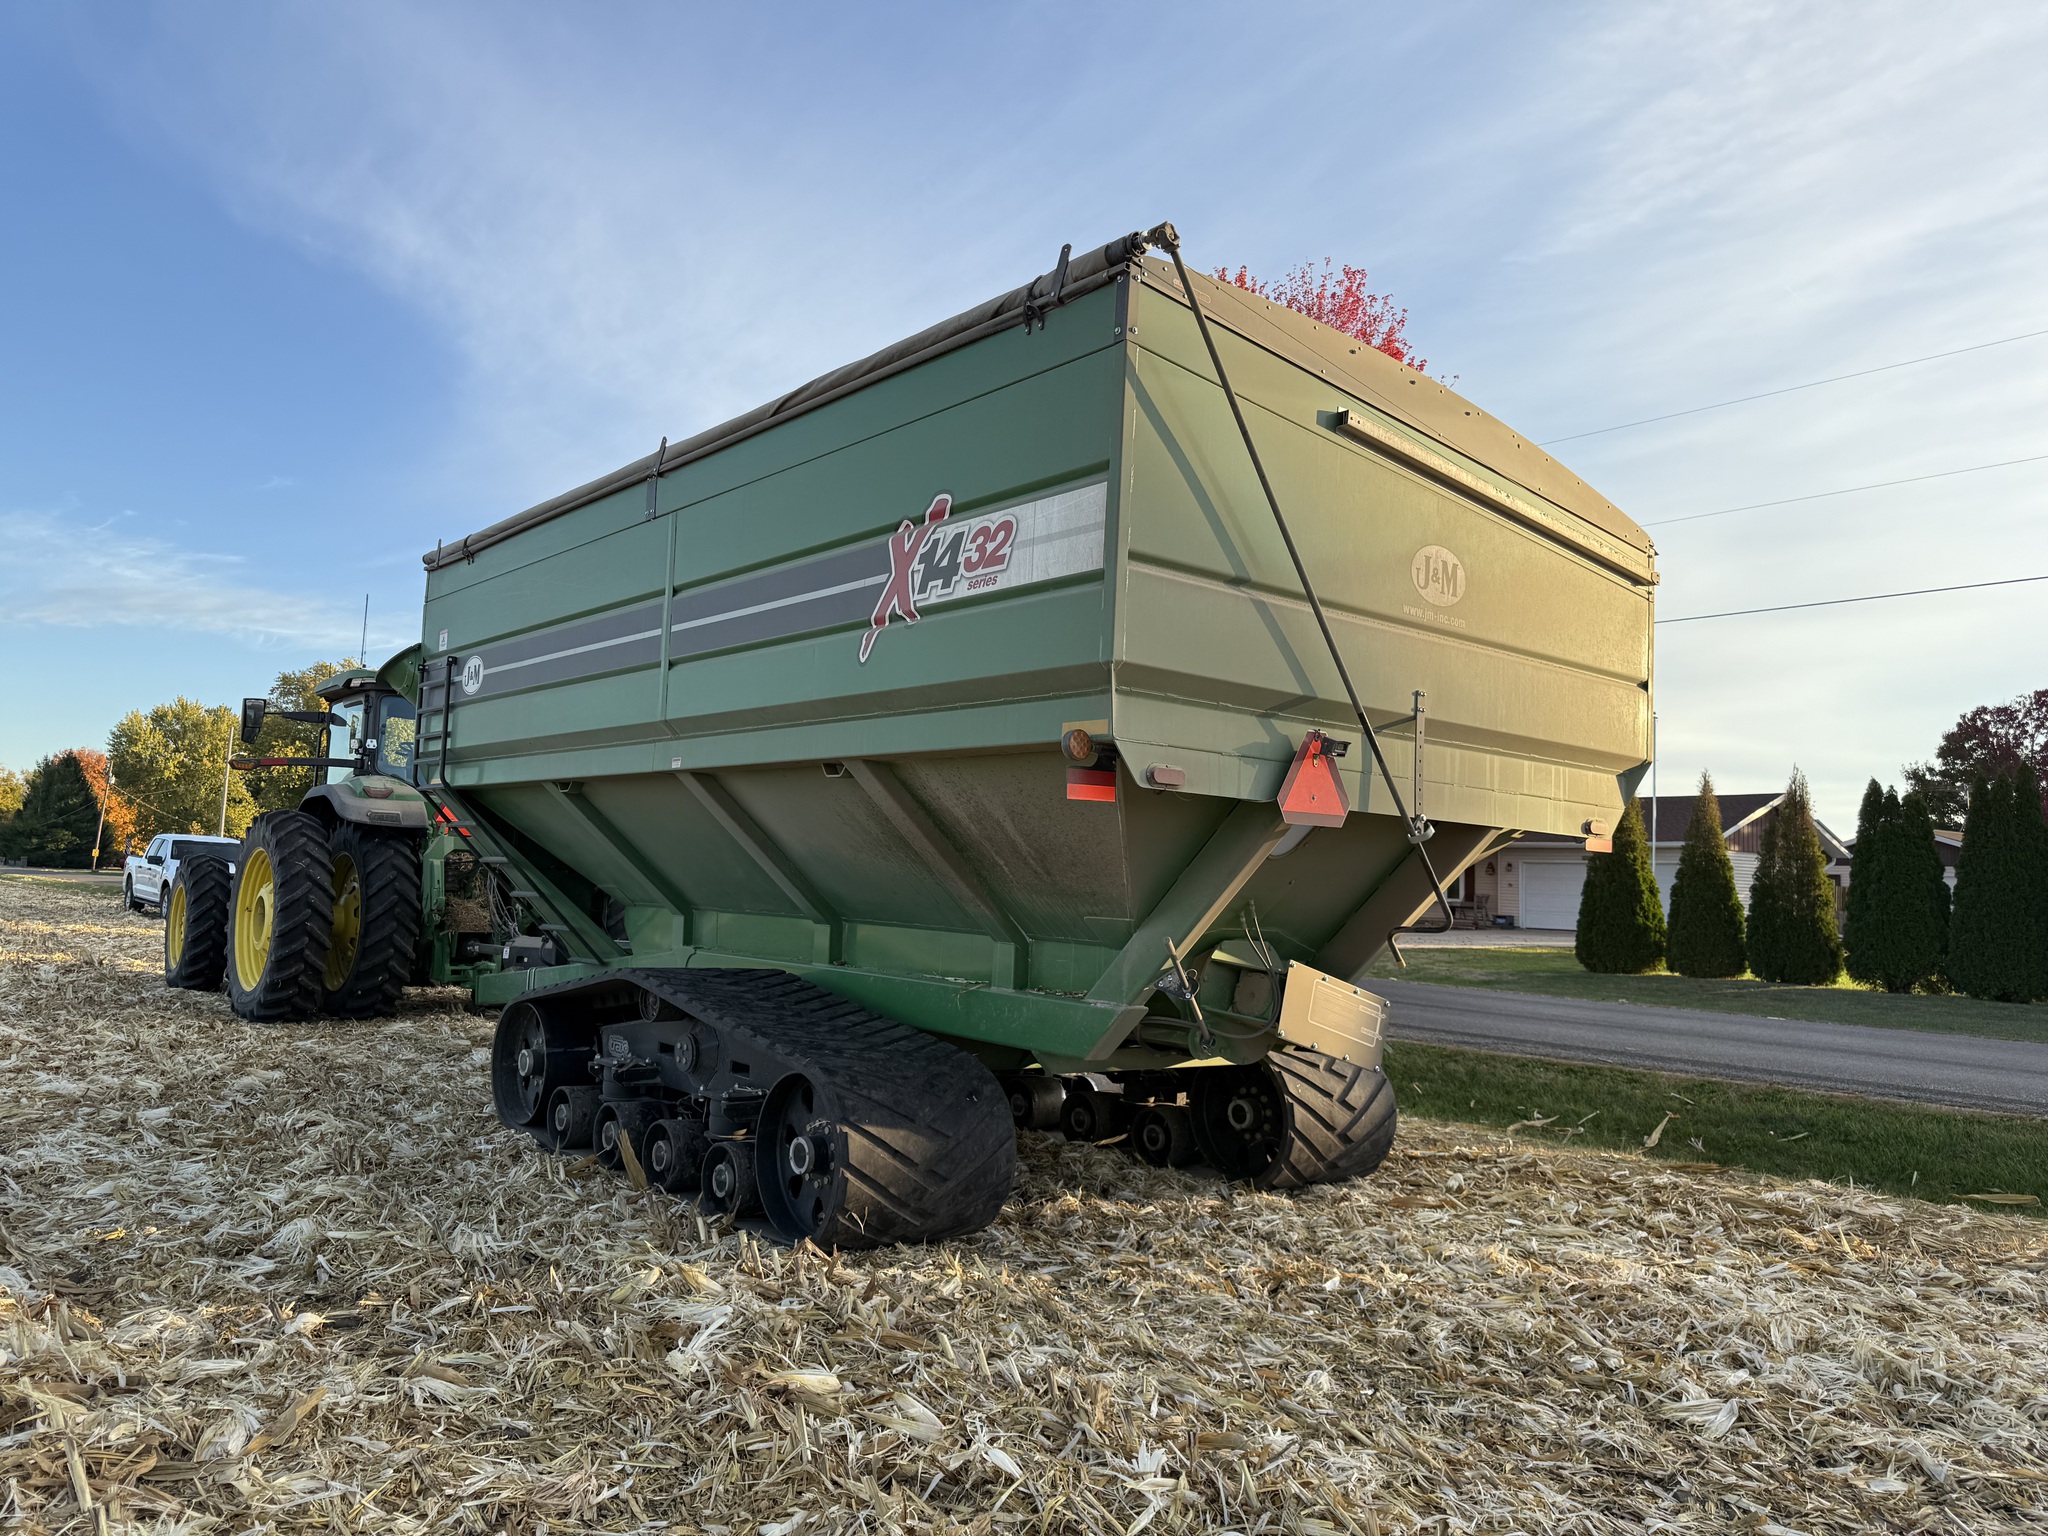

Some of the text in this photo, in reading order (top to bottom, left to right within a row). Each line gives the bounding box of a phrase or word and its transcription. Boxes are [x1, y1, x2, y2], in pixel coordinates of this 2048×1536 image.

[966, 574, 999, 592] series
[1415, 554, 1459, 598] J&M
[1402, 604, 1466, 629] www.jm-inc.com
